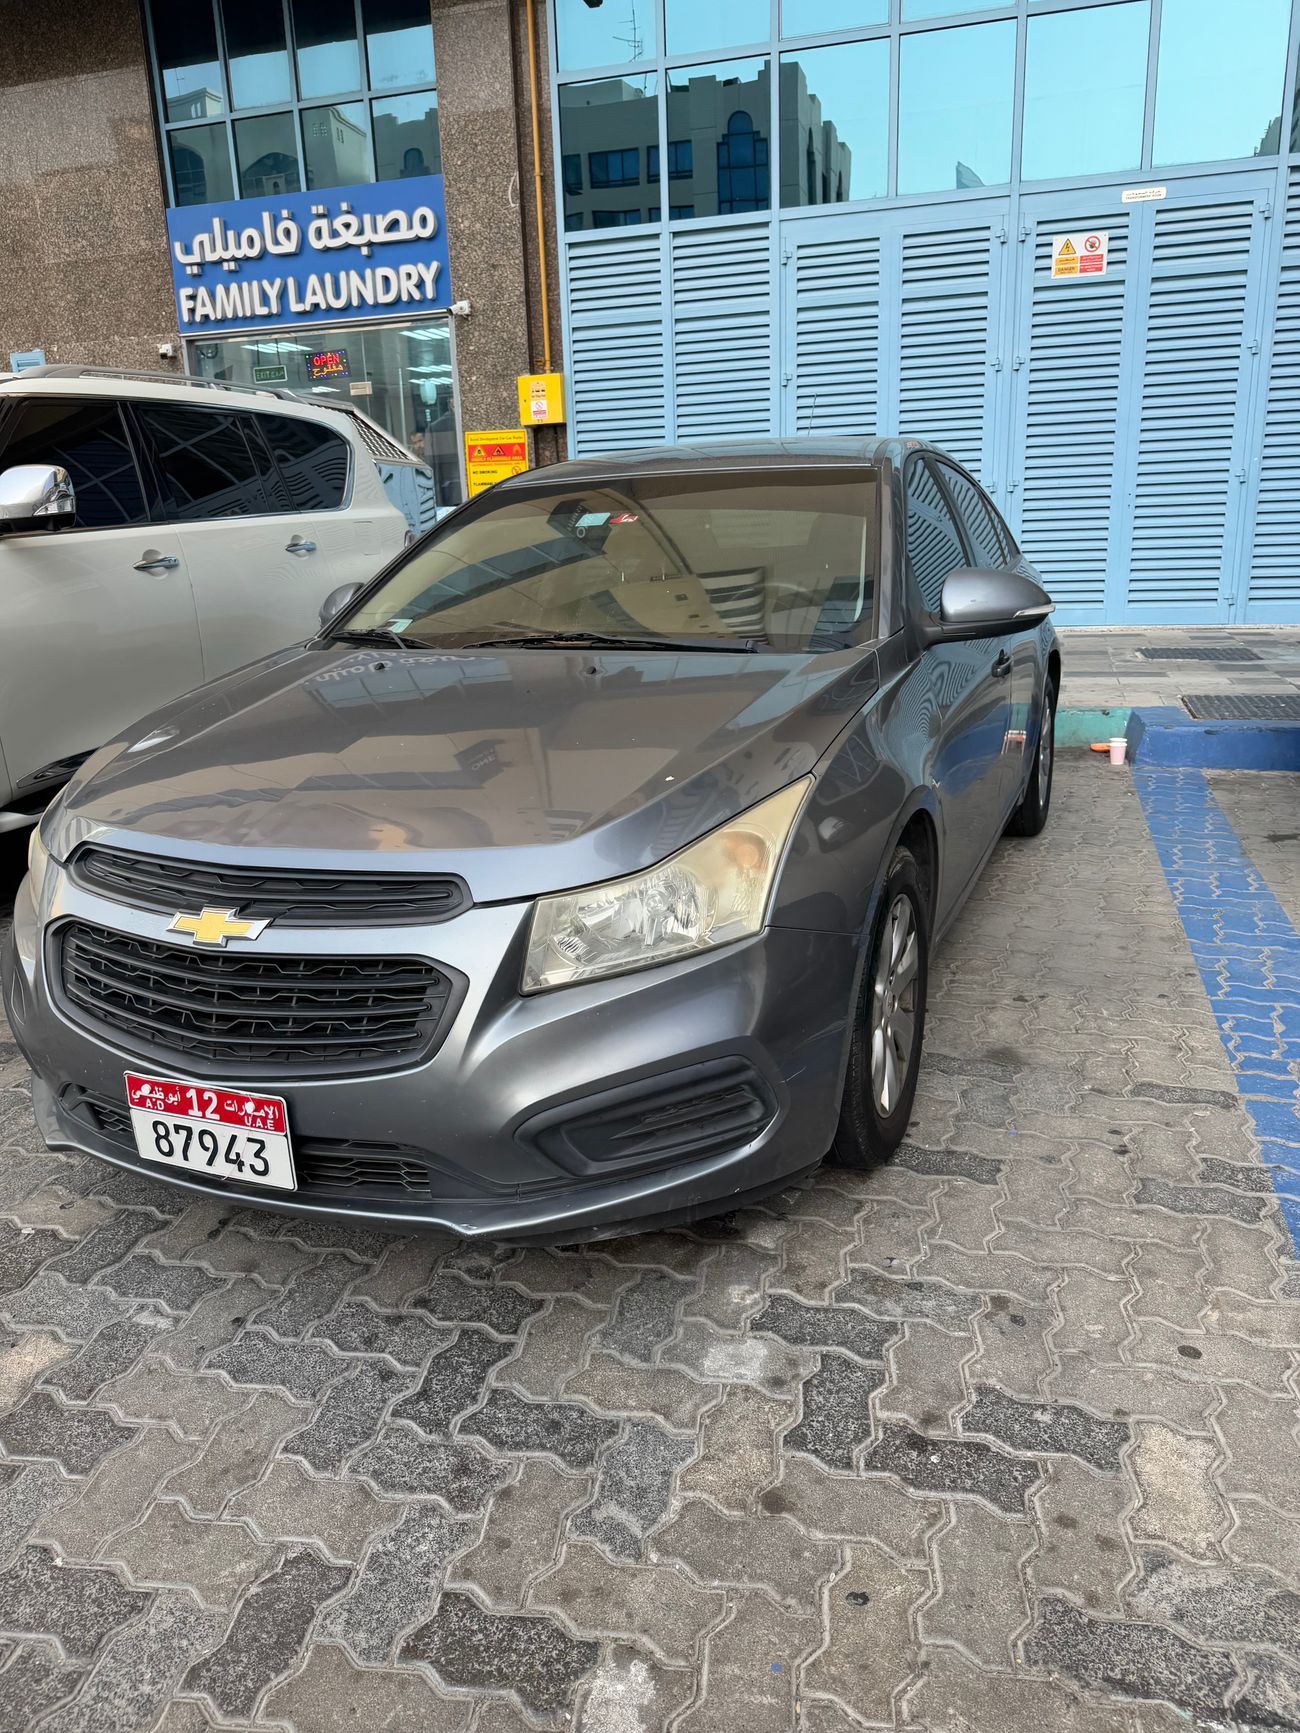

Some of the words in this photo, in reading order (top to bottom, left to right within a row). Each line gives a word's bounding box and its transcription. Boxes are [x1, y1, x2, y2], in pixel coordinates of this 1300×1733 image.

[308, 201, 438, 257] مصبغة
[173, 208, 300, 276] فاميلي
[178, 277, 282, 323] FAMILY
[286, 260, 441, 314] LAUNDRY
[311, 363, 344, 376] مفتوح
[313, 353, 340, 366] OPEN
[145, 1098, 165, 1110] A.D
[165, 1086, 181, 1105] أبو
[185, 1088, 220, 1120] 12
[244, 1115, 275, 1130] U.A.E
[152, 1120, 270, 1177] 87943
